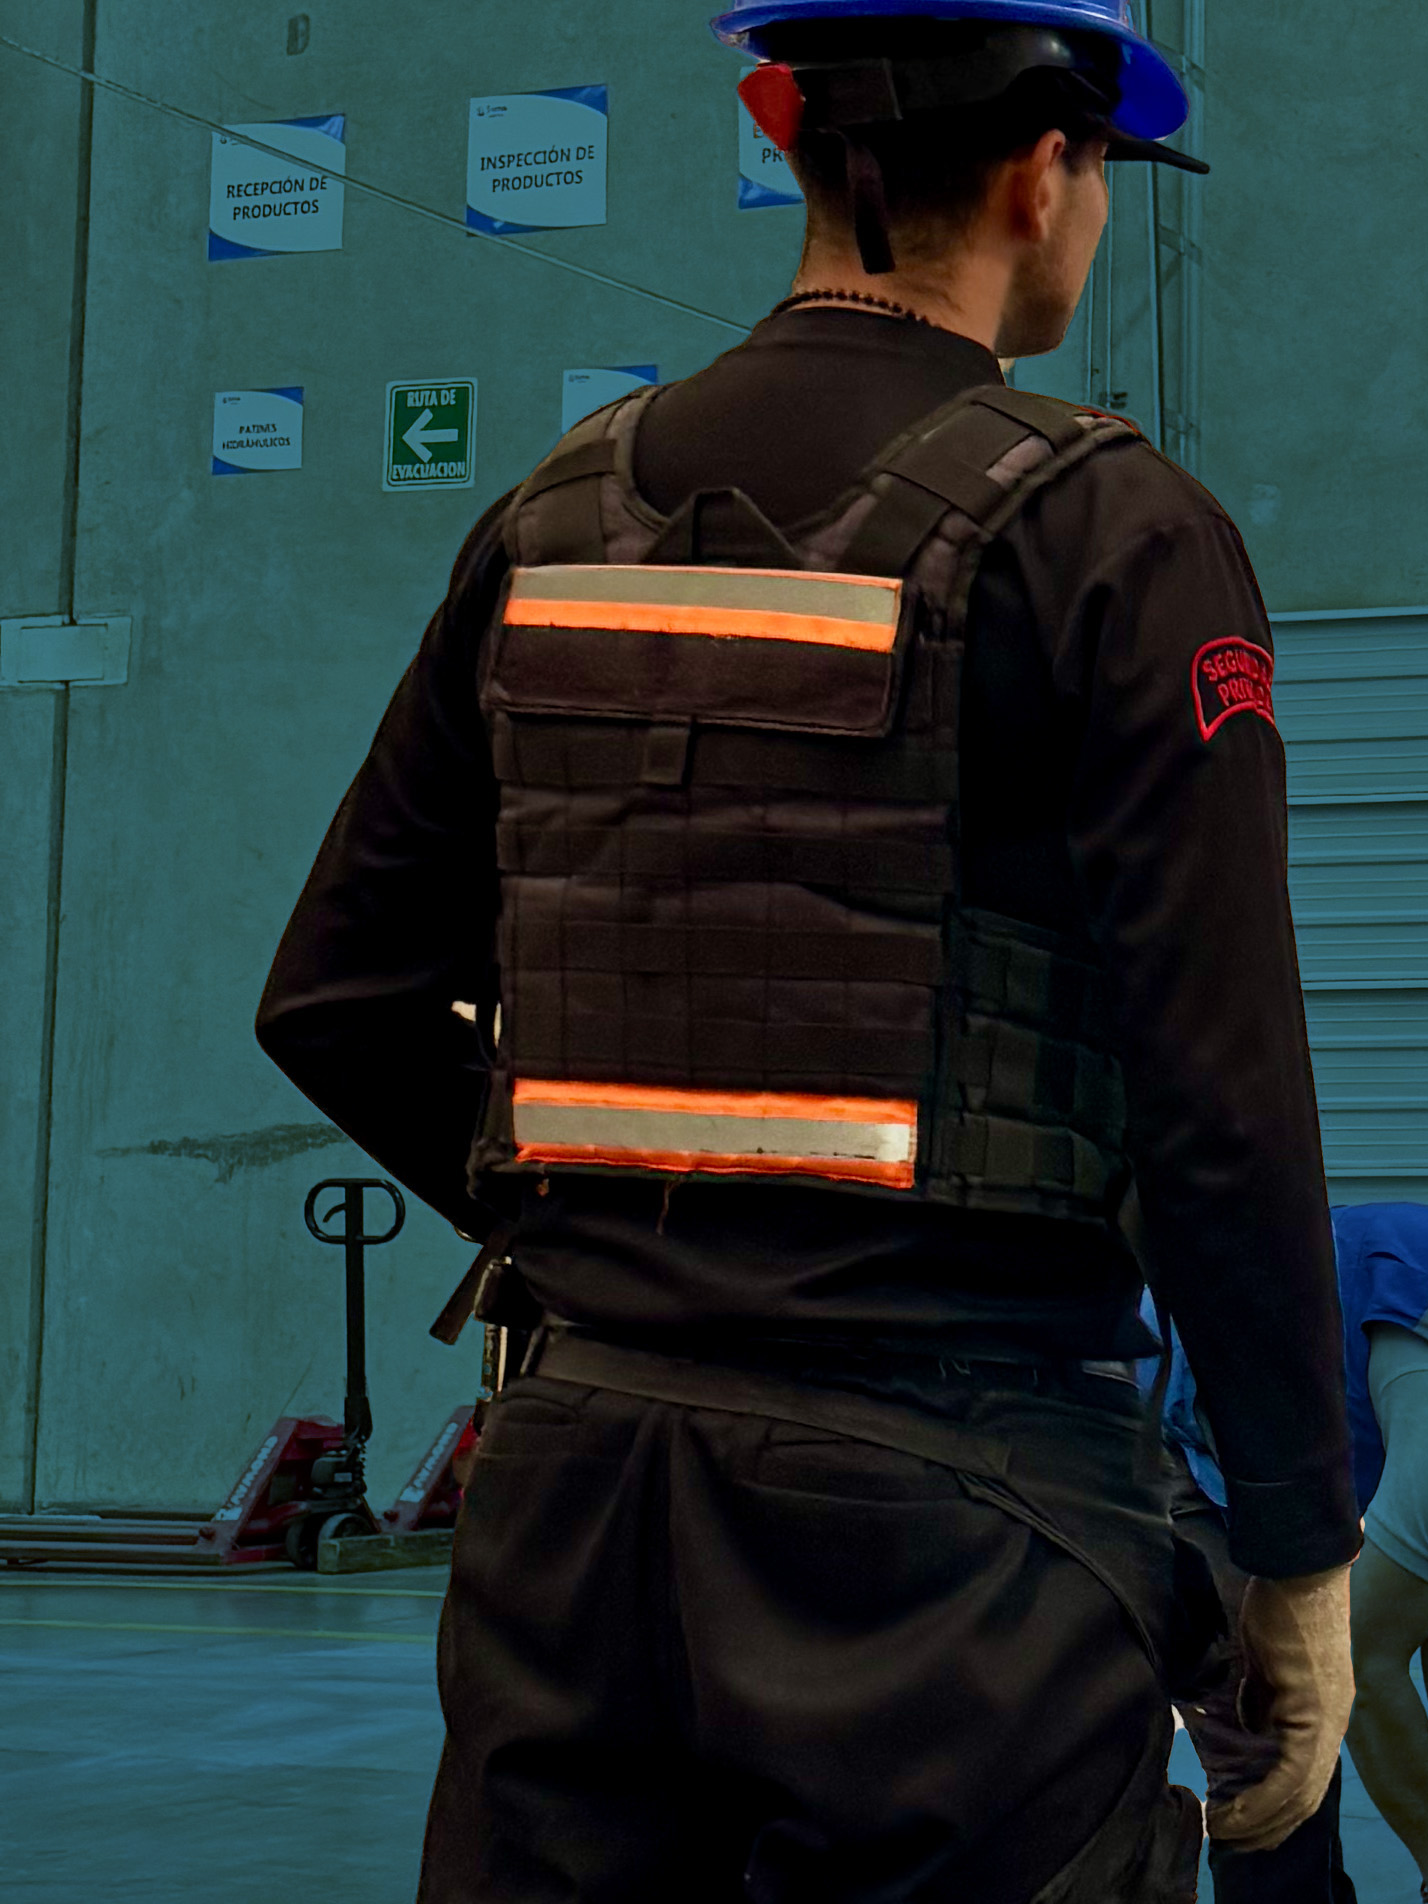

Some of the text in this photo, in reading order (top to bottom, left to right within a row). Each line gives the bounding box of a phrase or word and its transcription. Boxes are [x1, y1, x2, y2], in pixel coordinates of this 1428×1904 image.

[480, 144, 595, 171] INSPECCIÓN DE
[227, 176, 328, 198] RECEPCIÓN DE
[492, 170, 583, 193] PRODUCTOS
[233, 199, 319, 220] PRODUCTOS
[406, 388, 456, 408] RUTA DE
[391, 461, 466, 479] EVACUACION
